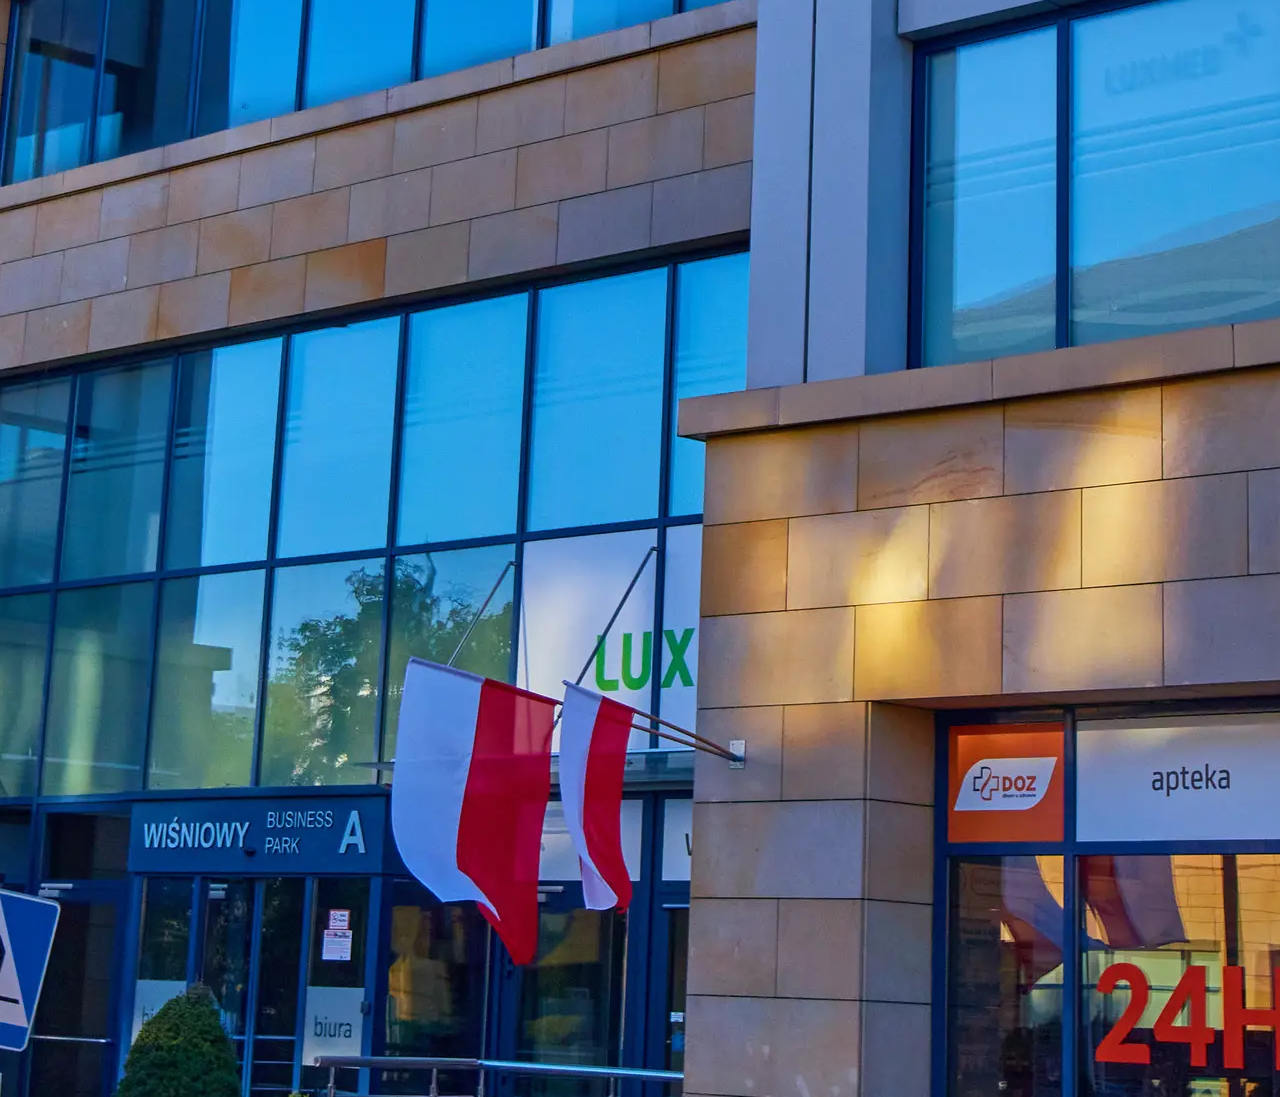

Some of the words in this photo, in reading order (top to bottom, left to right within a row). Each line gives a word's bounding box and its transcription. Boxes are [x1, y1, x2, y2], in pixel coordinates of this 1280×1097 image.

[595, 628, 696, 692] LUX
[1002, 775, 1036, 792] DOZ
[1151, 763, 1231, 797] apteka
[144, 816, 250, 848] WIŚNIOWY
[338, 810, 366, 854] A
[267, 810, 334, 829] BUSINESS
[265, 837, 301, 854] PARK
[314, 1014, 352, 1039] biura
